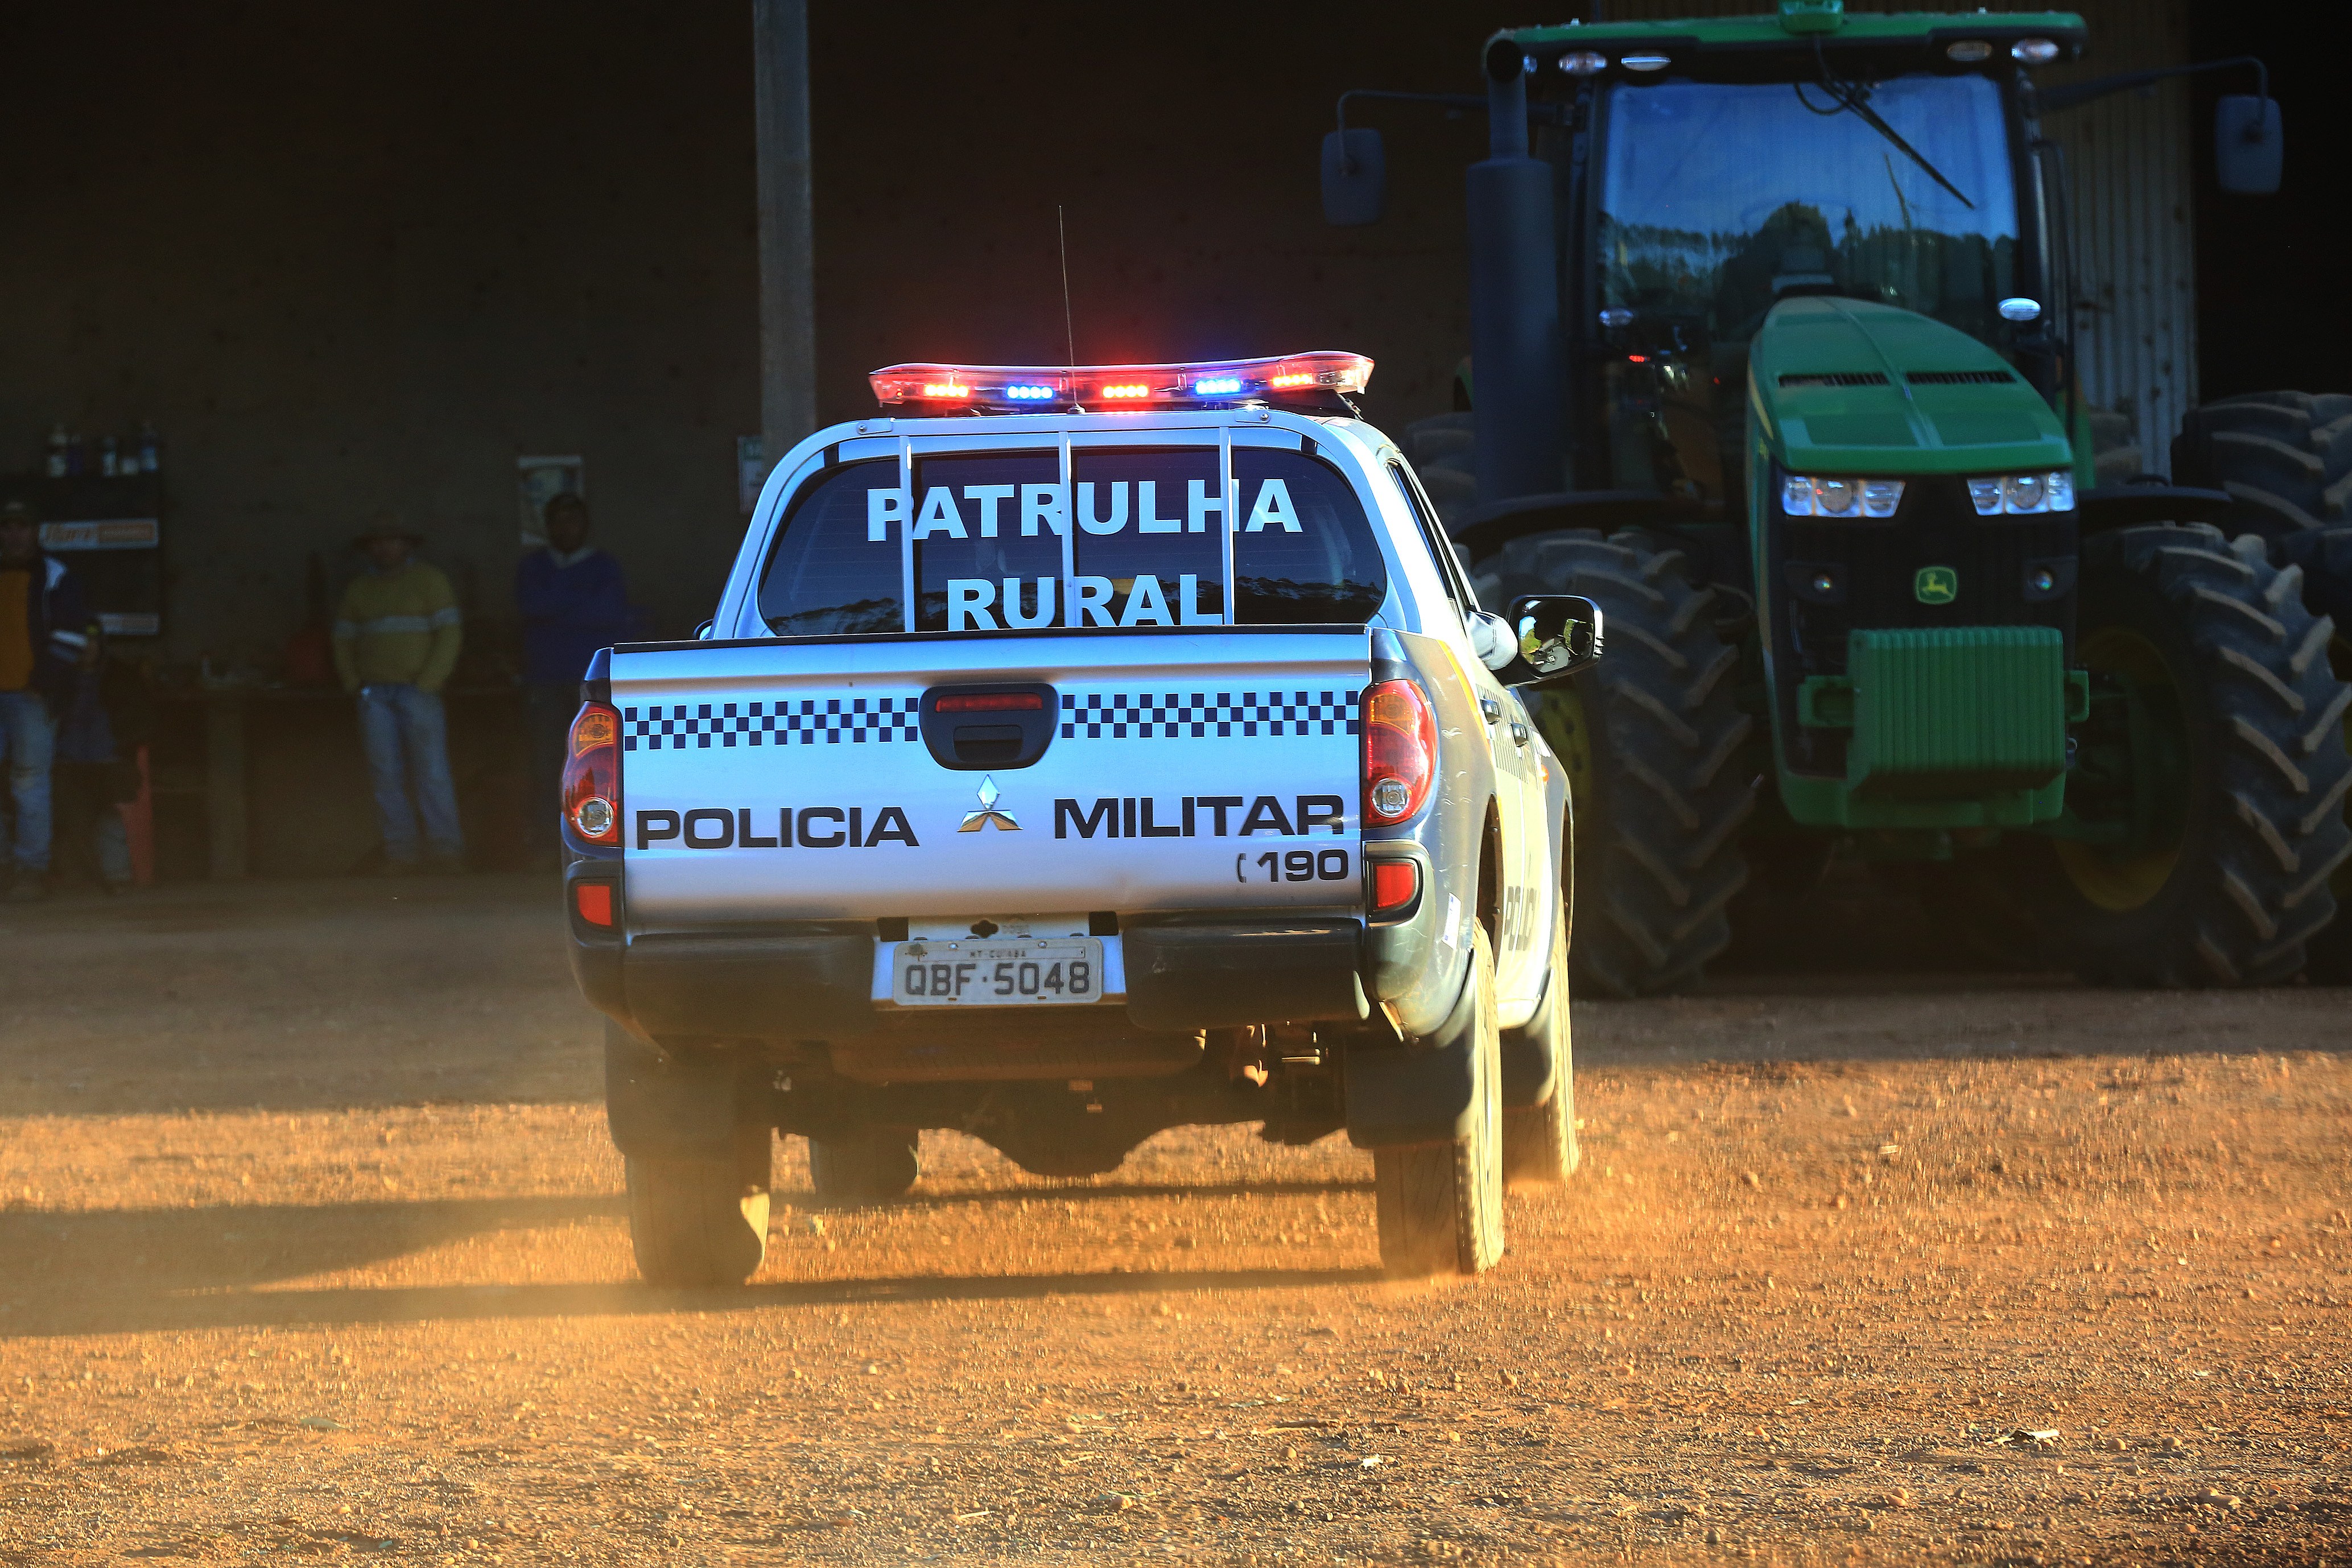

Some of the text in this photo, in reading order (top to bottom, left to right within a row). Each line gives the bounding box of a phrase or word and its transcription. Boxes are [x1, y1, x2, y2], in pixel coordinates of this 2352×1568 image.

[866, 479, 1303, 542] PATRULHA
[947, 574, 1222, 632] RURAL
[636, 795, 1344, 850] POLICIA MILITAR
[1257, 849, 1349, 882] 190
